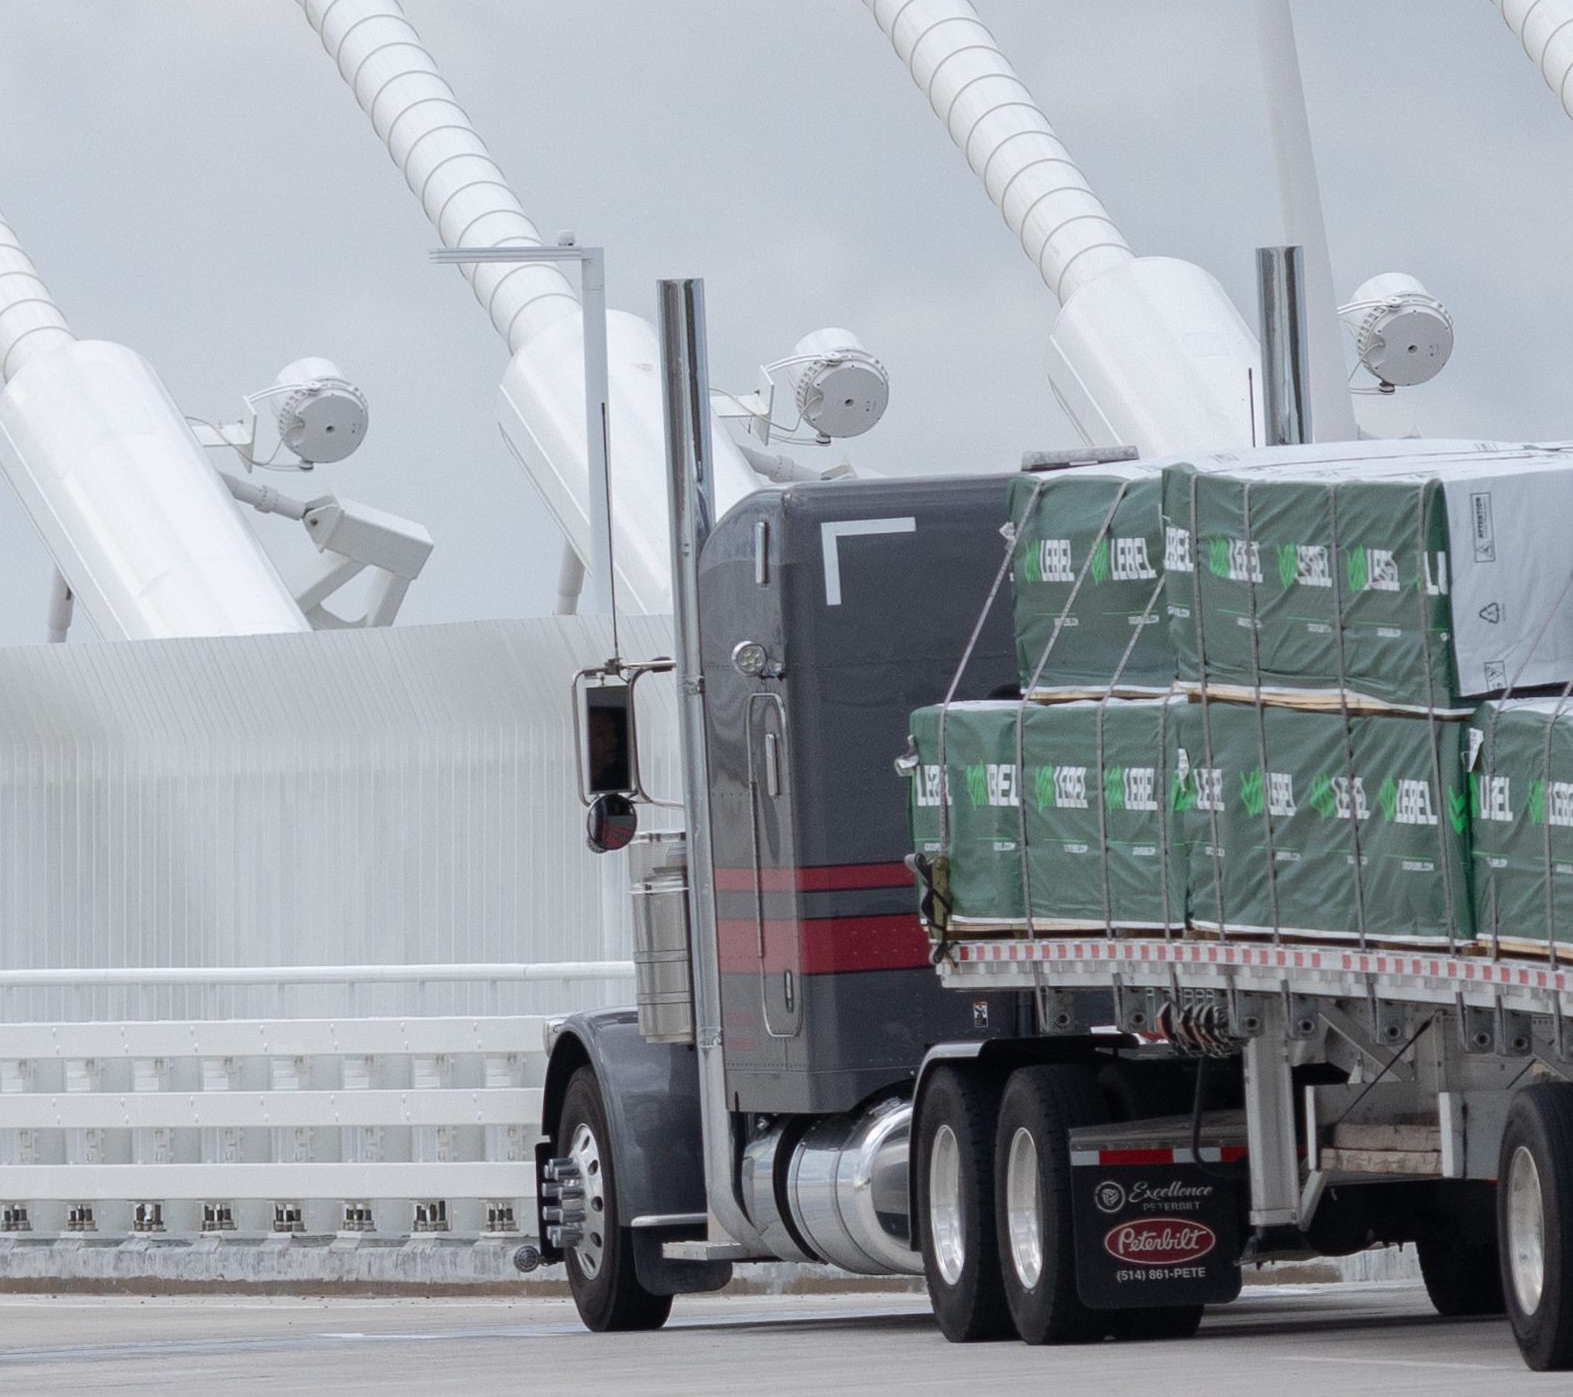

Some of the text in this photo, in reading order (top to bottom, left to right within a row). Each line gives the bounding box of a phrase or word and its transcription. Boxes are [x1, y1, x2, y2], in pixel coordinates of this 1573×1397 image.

[1395, 779, 1438, 825] LEBEL
[1128, 1181, 1213, 1203] Excellence
[1143, 1201, 1201, 1212] PETERBILT
[1118, 1227, 1207, 1254] Peterbilt
[1117, 1267, 1206, 1282] (514) 861-PETE
